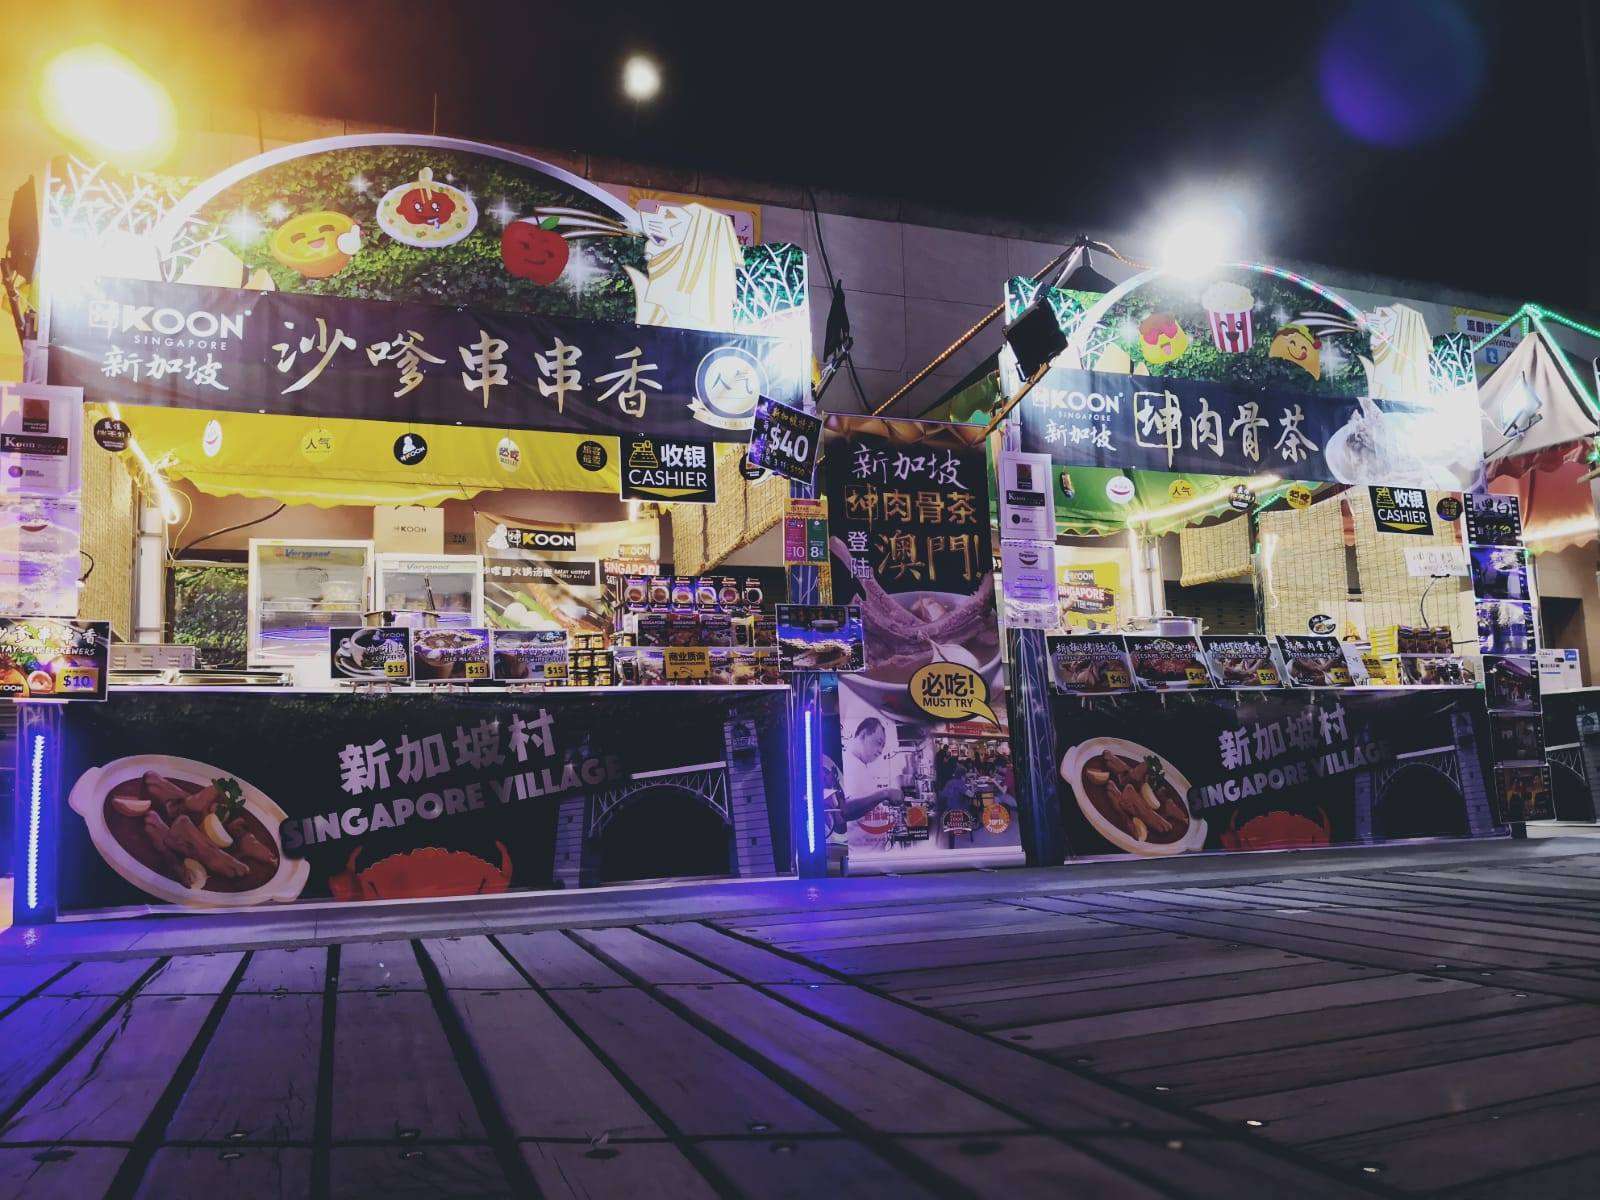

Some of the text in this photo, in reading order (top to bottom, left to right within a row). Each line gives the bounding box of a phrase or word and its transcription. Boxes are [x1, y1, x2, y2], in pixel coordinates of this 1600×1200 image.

[121, 306, 244, 340] KOON
[134, 335, 228, 352] SINGAPORE
[101, 345, 230, 392] 新加坡
[712, 369, 754, 394] 人气
[1051, 391, 1121, 414] KOON
[1058, 412, 1112, 423] SINGAPORE
[770, 422, 809, 463] $40
[1044, 419, 1117, 452] 新加坡
[660, 443, 707, 469] 收银
[851, 443, 969, 491] 新加坡
[628, 469, 708, 488] CASHIER
[1394, 489, 1425, 509] 收银
[1377, 508, 1428, 524] CASHIER
[522, 532, 575, 547] KOON
[847, 530, 874, 580] 登陆
[63, 675, 92, 687] $10
[387, 665, 405, 673] $15
[468, 665, 485, 674] $15
[546, 665, 564, 674] $15
[921, 672, 975, 696] 必吃!
[922, 697, 974, 709] MUST TRY
[1217, 702, 1349, 771] 新加坡村
[338, 708, 557, 796] 新加坡村
[492, 754, 624, 804] VILLAGE
[283, 782, 485, 851] SINGAPORE
